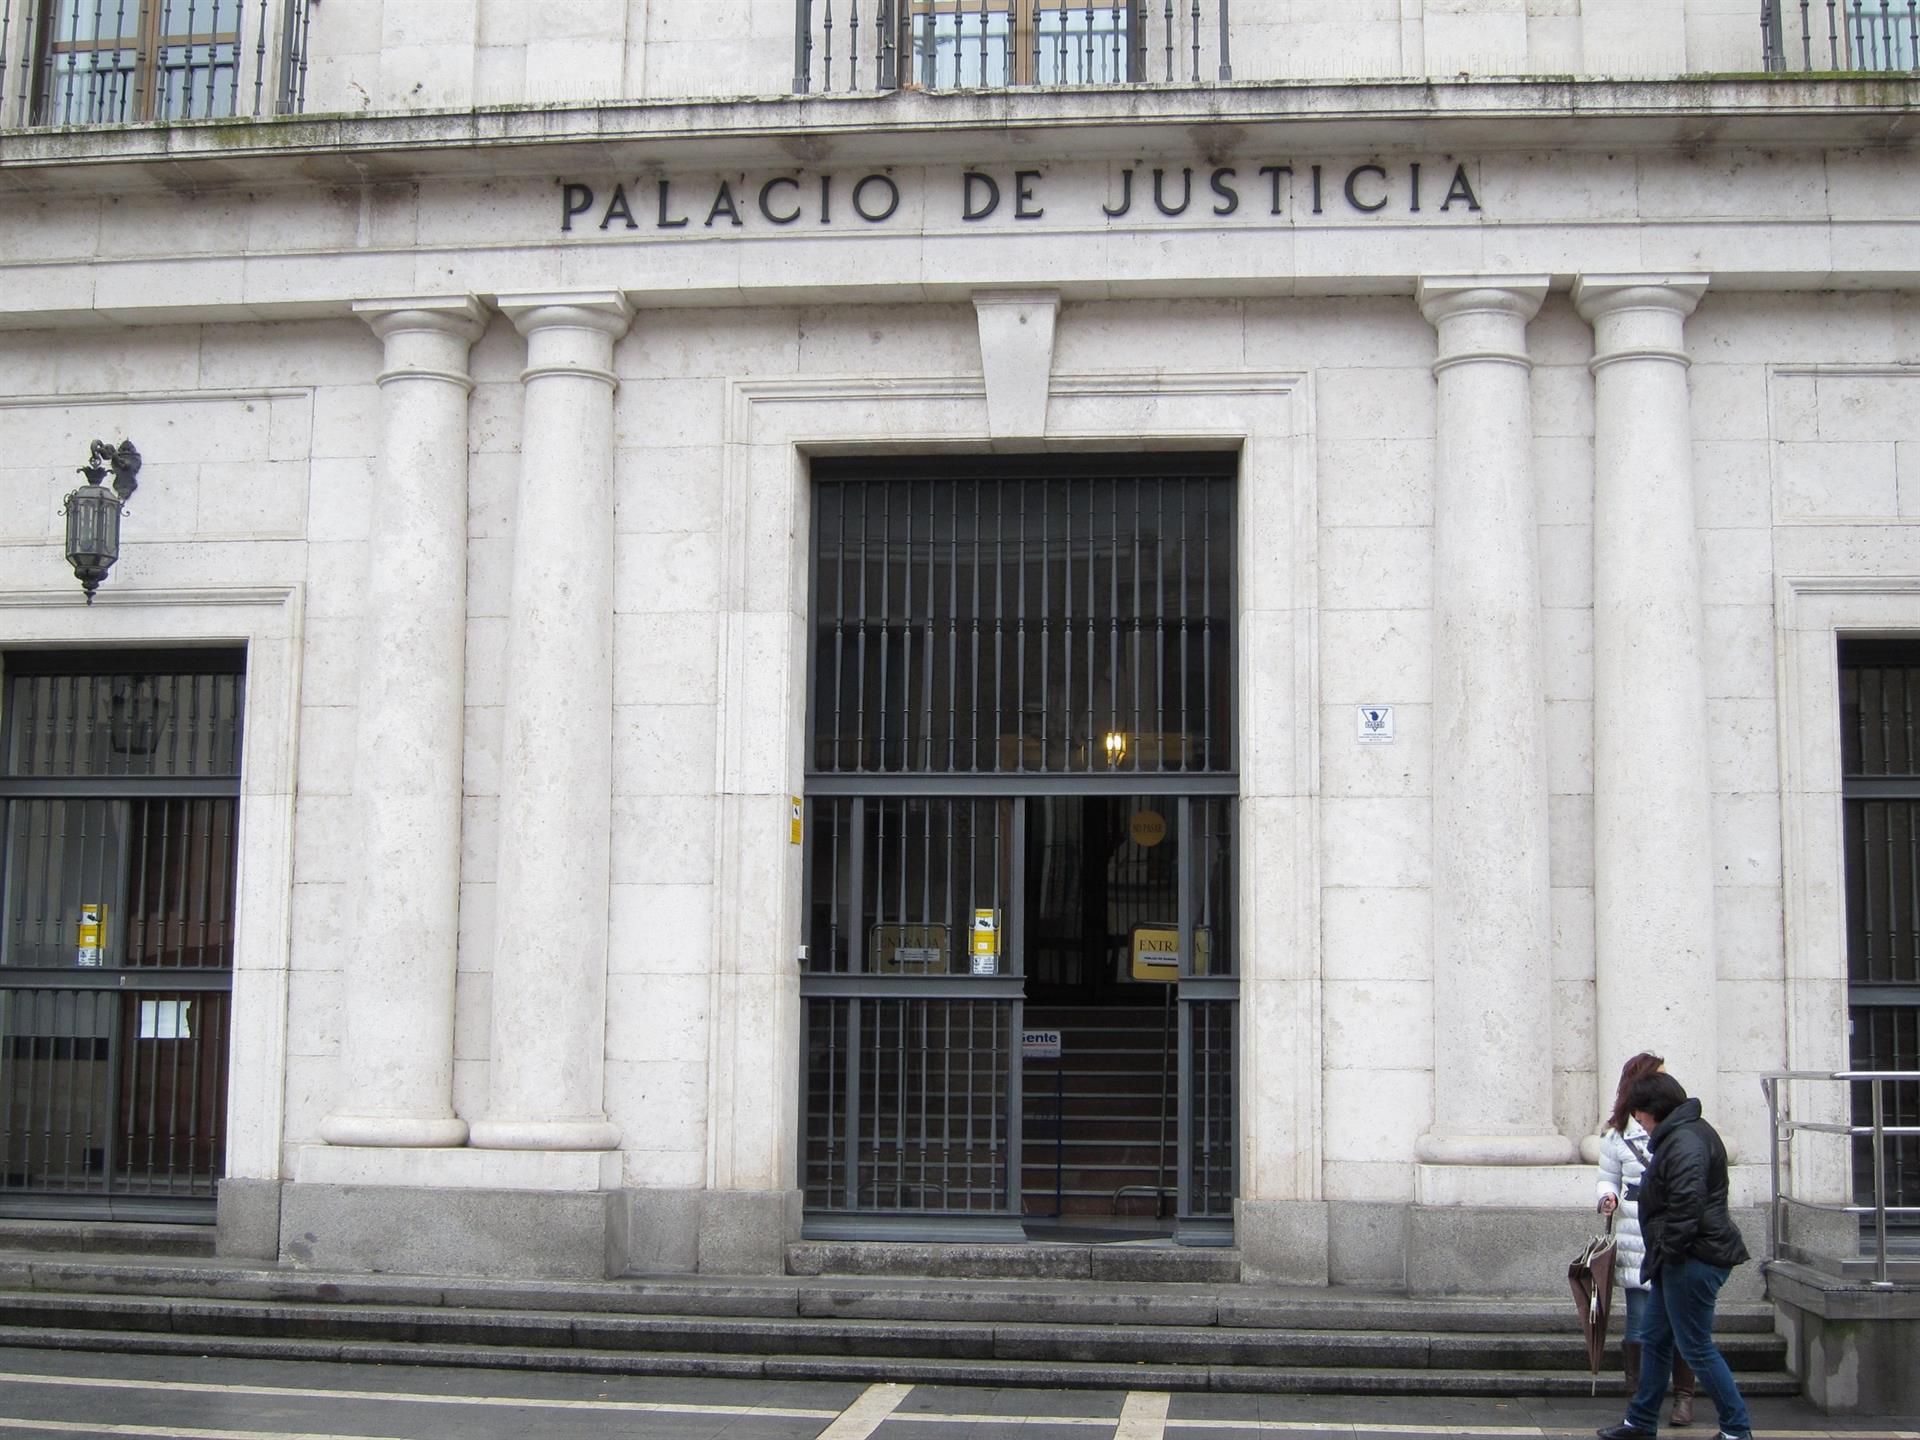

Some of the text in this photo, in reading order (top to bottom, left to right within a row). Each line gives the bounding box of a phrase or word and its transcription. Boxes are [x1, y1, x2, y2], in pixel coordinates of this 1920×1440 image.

[560, 163, 1480, 232] PALACIO DE JUSTICIA
[1022, 1032, 1058, 1043] iente
